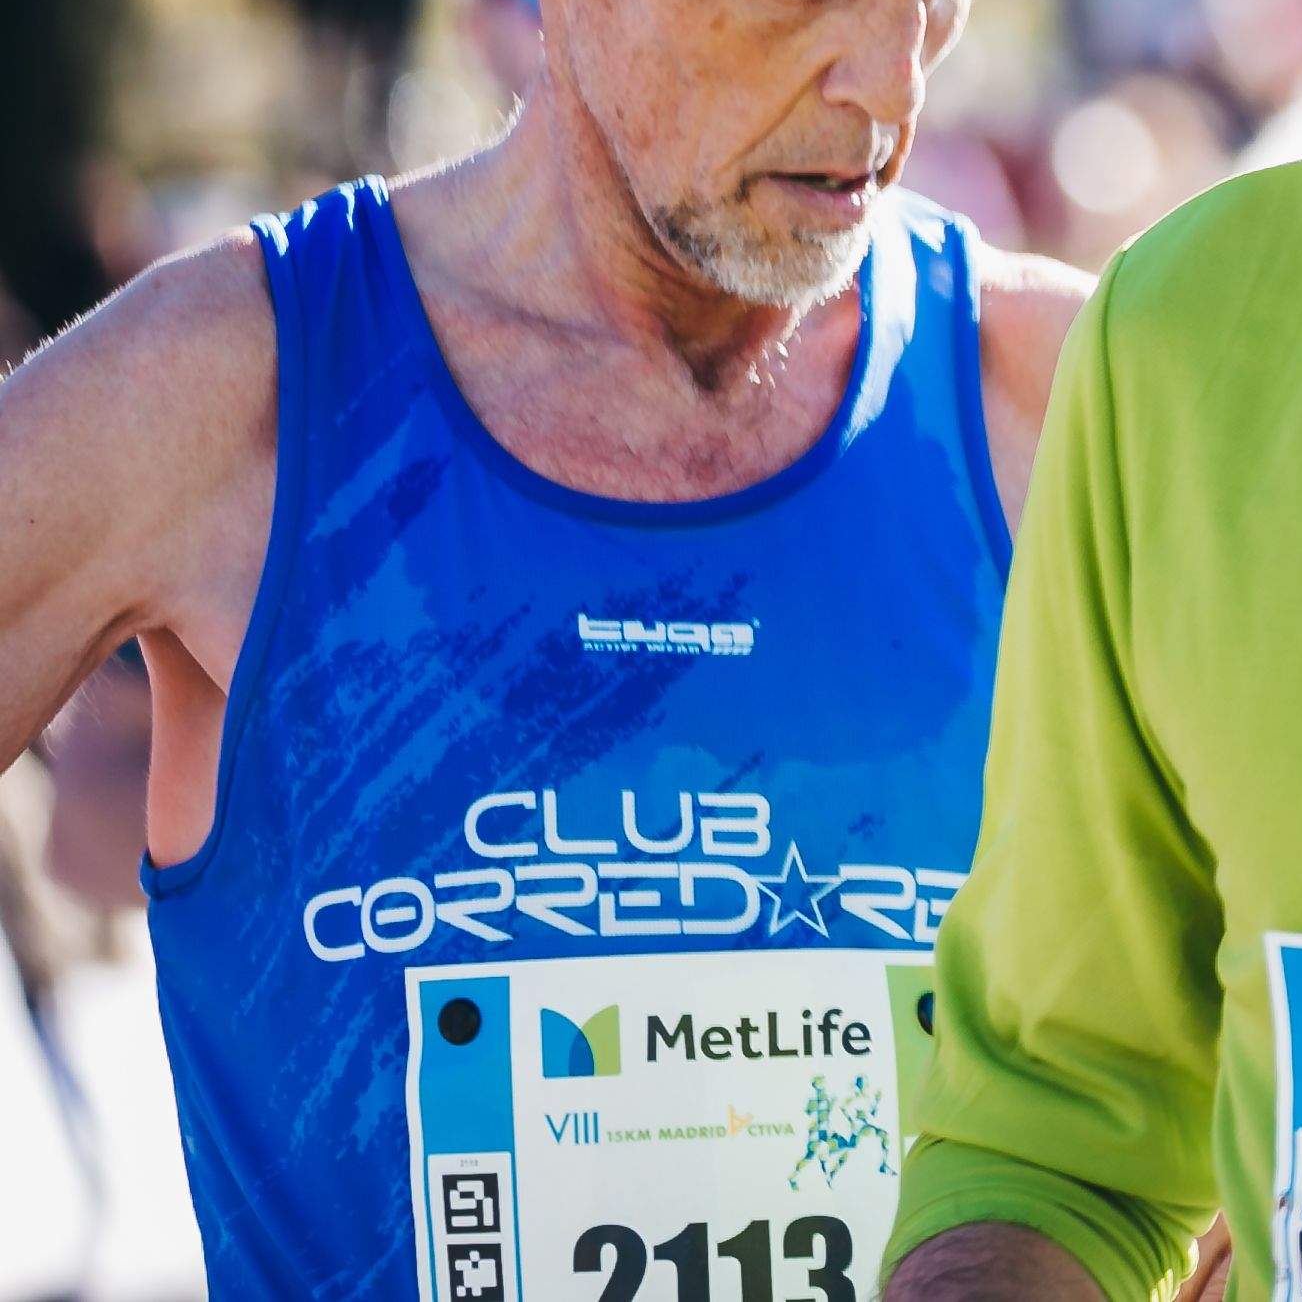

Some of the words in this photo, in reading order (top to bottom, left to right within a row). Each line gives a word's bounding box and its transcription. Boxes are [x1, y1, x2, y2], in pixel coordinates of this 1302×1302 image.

[464, 789, 770, 858] CLUB
[645, 1009, 872, 1063] MetLife
[545, 1112, 600, 1145] VIII
[607, 1129, 651, 1143] 15KM
[658, 1126, 727, 1141] MADRID
[573, 1215, 856, 1302] 2113
